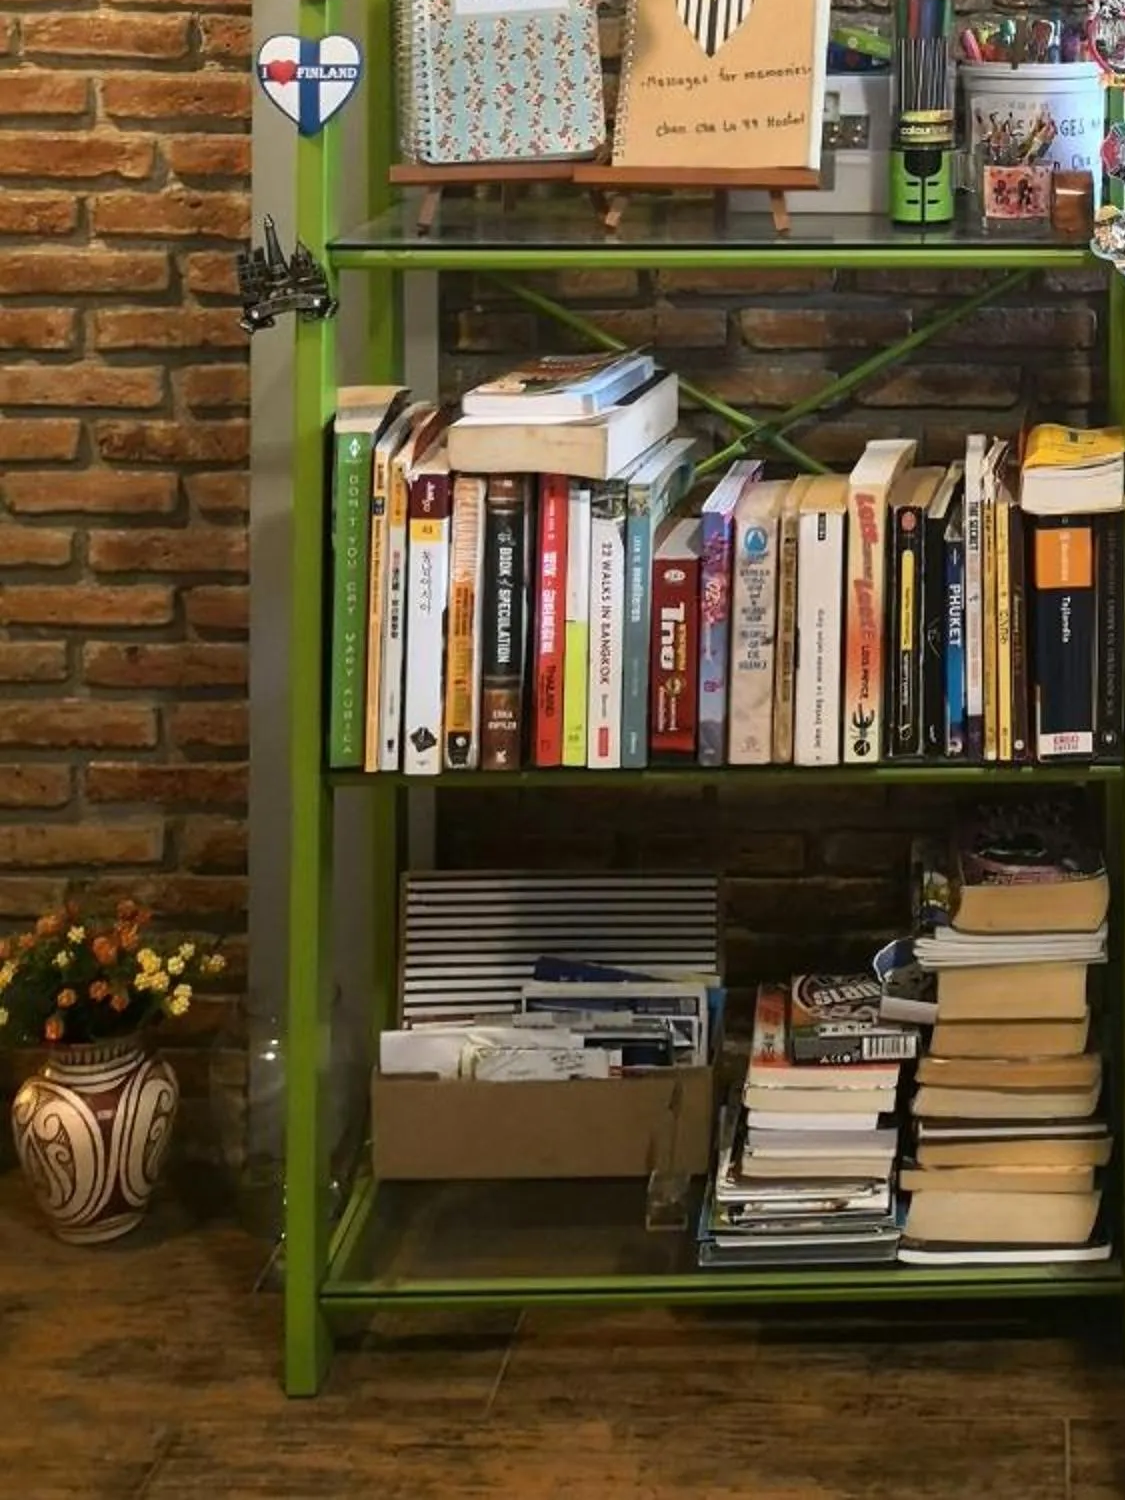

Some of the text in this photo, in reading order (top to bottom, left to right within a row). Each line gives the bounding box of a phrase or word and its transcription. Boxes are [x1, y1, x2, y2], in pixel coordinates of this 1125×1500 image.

[296, 66, 357, 79] FINLAND
[969, 502, 978, 517] THE
[602, 542, 612, 558] 22
[969, 519, 978, 551] SECRET
[498, 548, 510, 576] BOOK
[601, 560, 612, 601] WALKS
[497, 588, 510, 663] SPECULATION
[601, 606, 611, 619] IN
[949, 583, 961, 648] PHUKET
[1061, 596, 1071, 643] Tajlandia
[599, 622, 611, 685] BANGKOK
